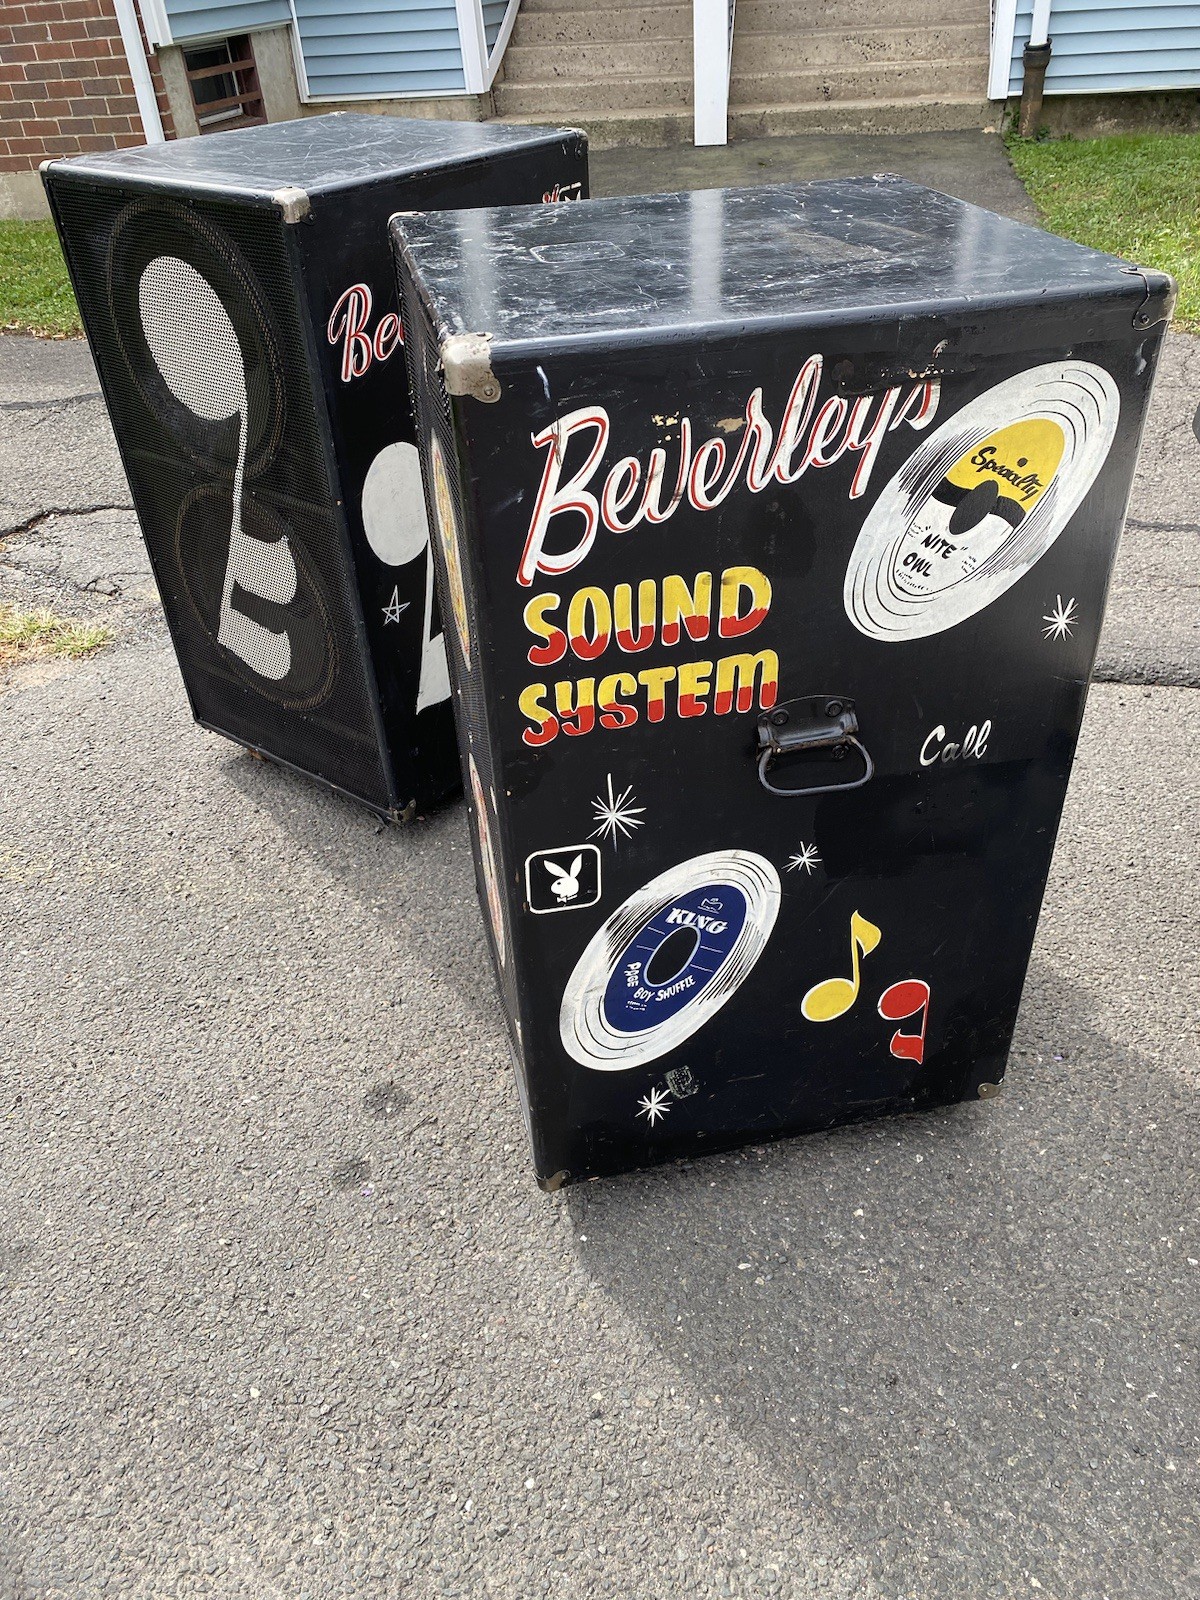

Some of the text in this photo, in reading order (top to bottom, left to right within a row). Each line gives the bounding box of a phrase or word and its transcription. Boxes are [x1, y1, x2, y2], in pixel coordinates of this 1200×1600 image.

[328, 283, 405, 382] Be
[902, 552, 933, 577] OWL
[523, 566, 773, 667] SOUND
[518, 649, 779, 748] SYSTEM
[919, 719, 992, 767] Call
[665, 907, 728, 934] KING
[633, 987, 656, 1002] BOY
[655, 975, 696, 1002] SHUFFLE
